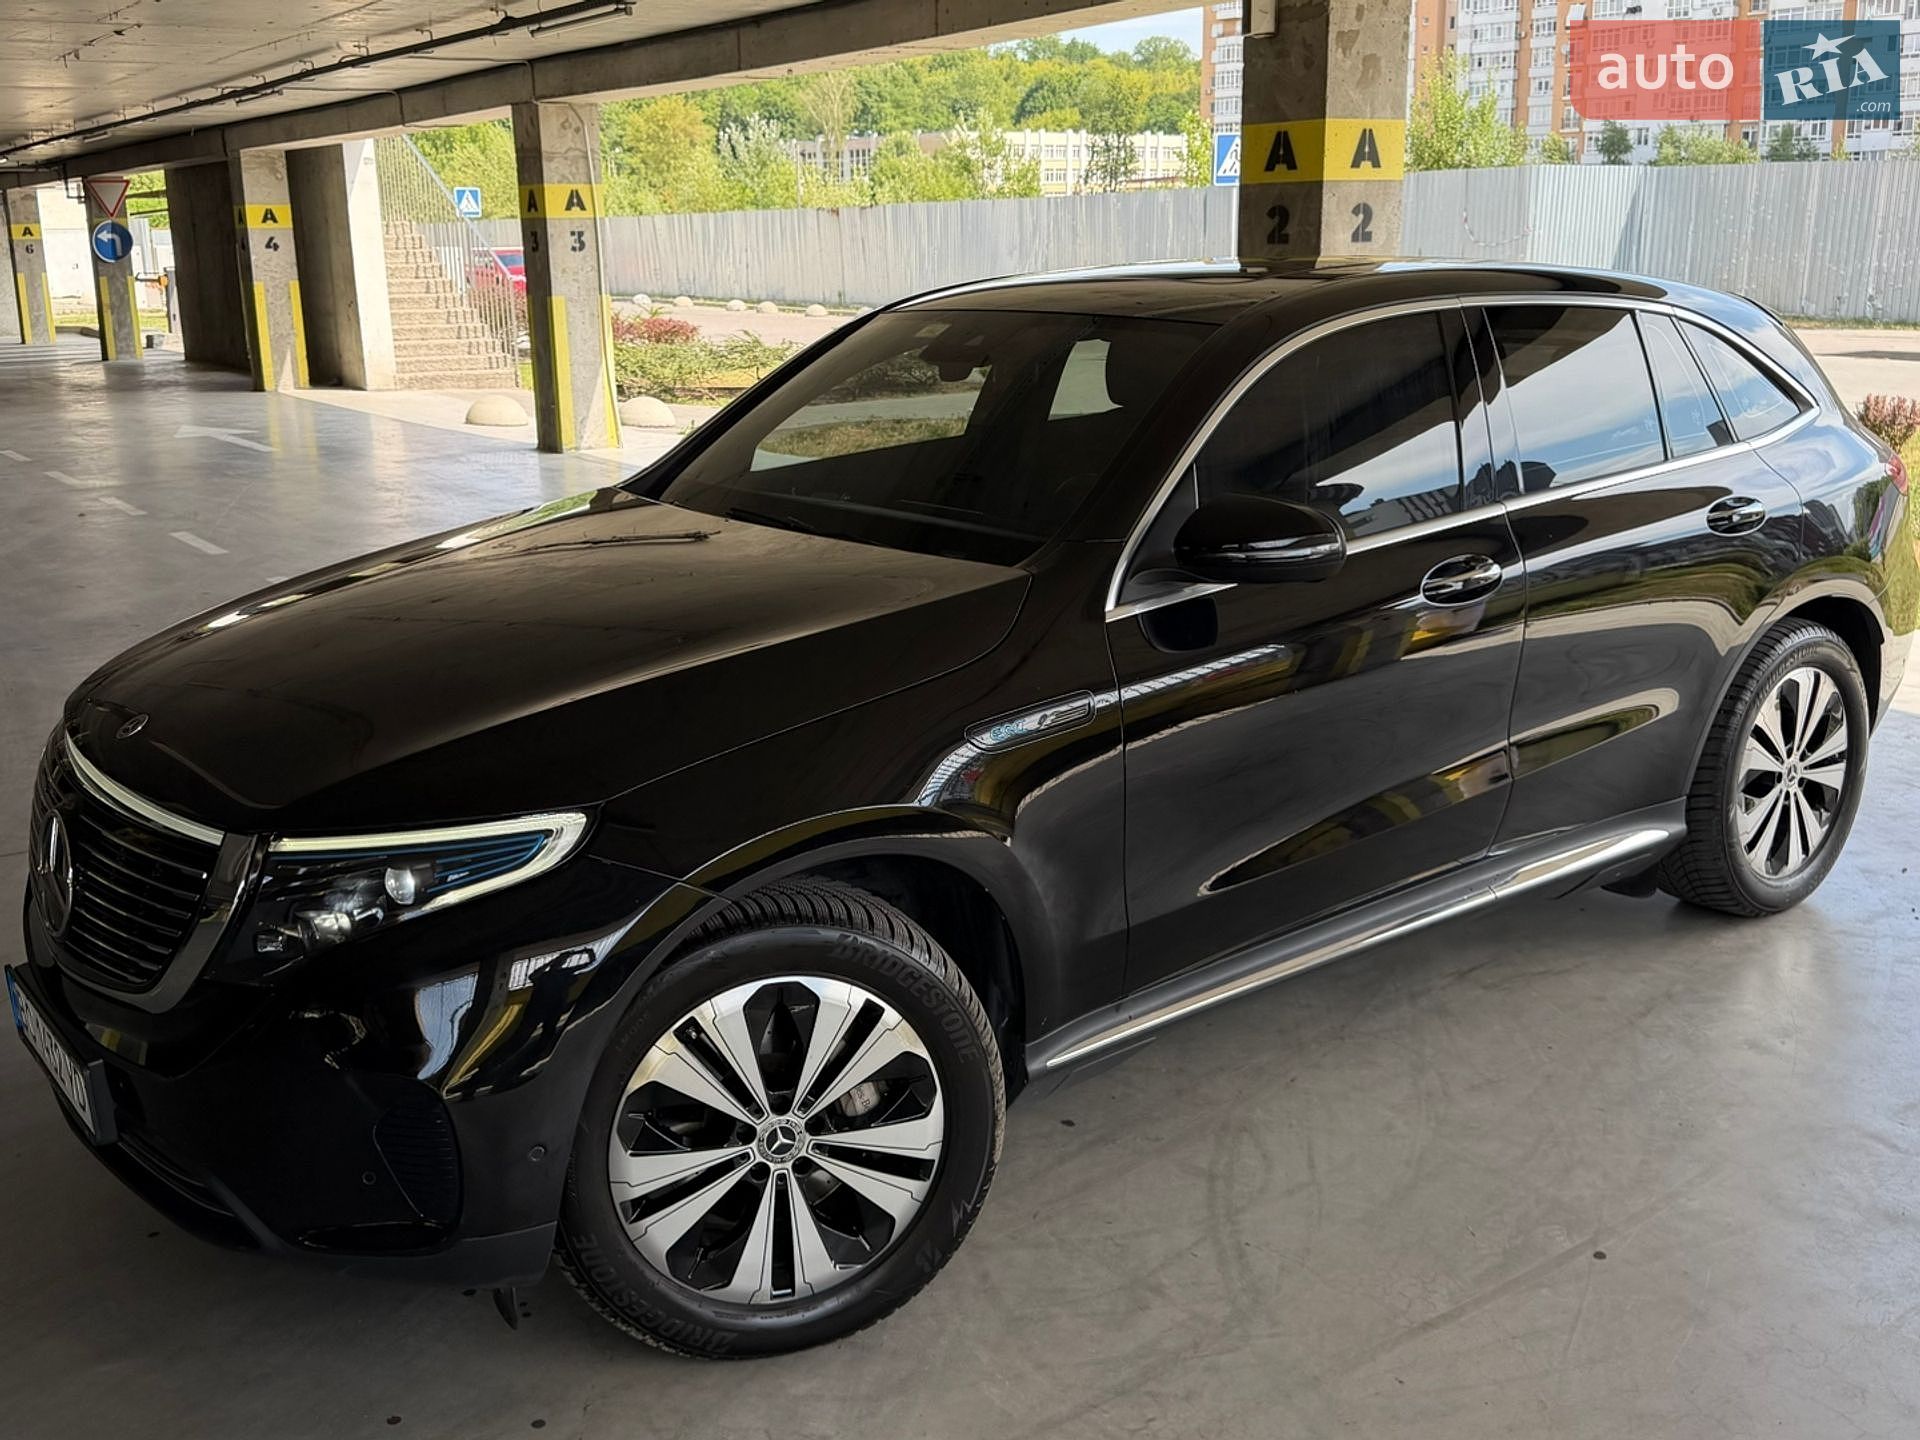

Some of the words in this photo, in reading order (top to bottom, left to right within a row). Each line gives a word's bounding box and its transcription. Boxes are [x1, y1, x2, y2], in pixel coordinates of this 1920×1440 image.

[1264, 130, 1298, 172] A
[1350, 127, 1382, 169] A
[527, 188, 539, 213] A
[564, 188, 587, 211] A
[261, 207, 279, 224] A
[1266, 204, 1290, 244] 2
[1351, 202, 1373, 242] 2
[21, 226, 34, 237] A
[264, 235, 280, 252] 4
[530, 230, 540, 253] 3
[569, 230, 586, 252] 3
[25, 243, 35, 255] 6
[832, 933, 981, 1065] BRIDGESTONE
[572, 1232, 739, 1353] BRIDGESTONE
